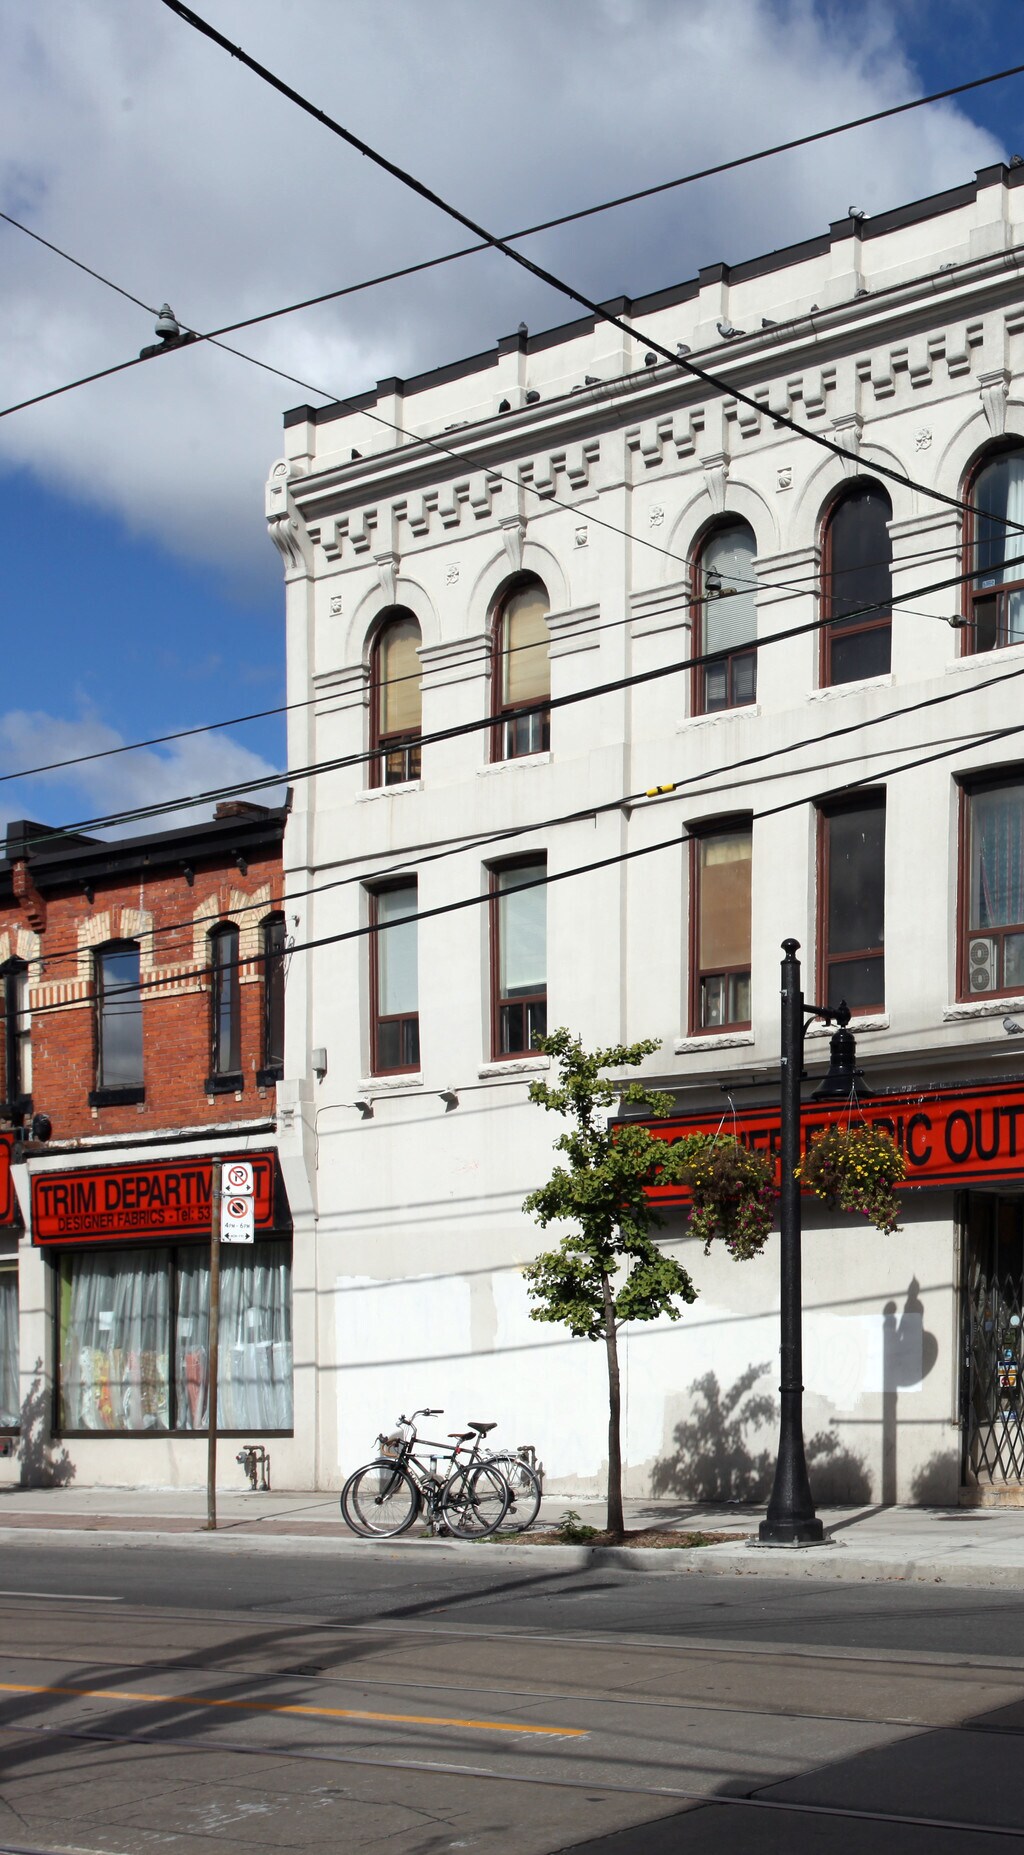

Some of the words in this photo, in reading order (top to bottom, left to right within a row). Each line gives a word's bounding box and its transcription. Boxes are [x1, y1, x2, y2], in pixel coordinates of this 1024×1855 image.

[39, 1181, 97, 1217] TRIM
[104, 1166, 267, 1212] DEPARTMT
[58, 1212, 114, 1232] DESIGNER
[117, 1209, 165, 1228] FABRICS
[174, 1207, 194, 1222] Tel:
